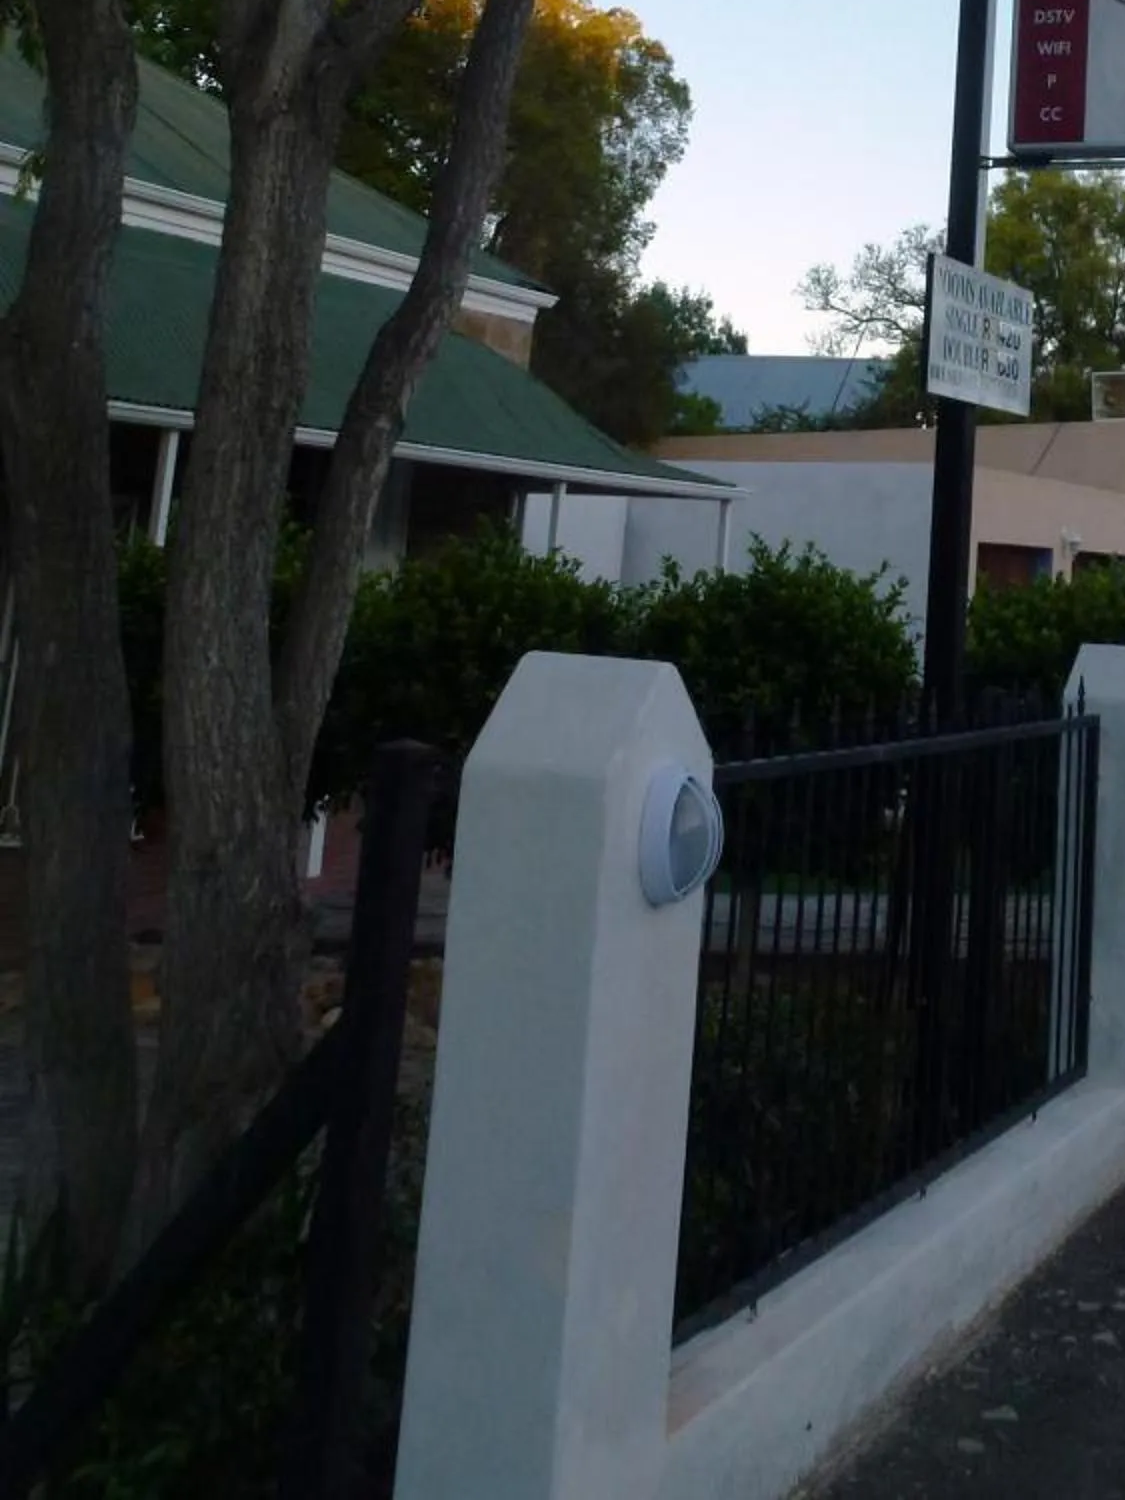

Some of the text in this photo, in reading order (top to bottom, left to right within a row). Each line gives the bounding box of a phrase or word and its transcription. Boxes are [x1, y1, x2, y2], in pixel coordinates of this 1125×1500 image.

[1034, 9, 1076, 24] DSTV
[1037, 40, 1072, 55] WIFI
[1047, 74, 1057, 88] P
[1040, 106, 1063, 121] CC
